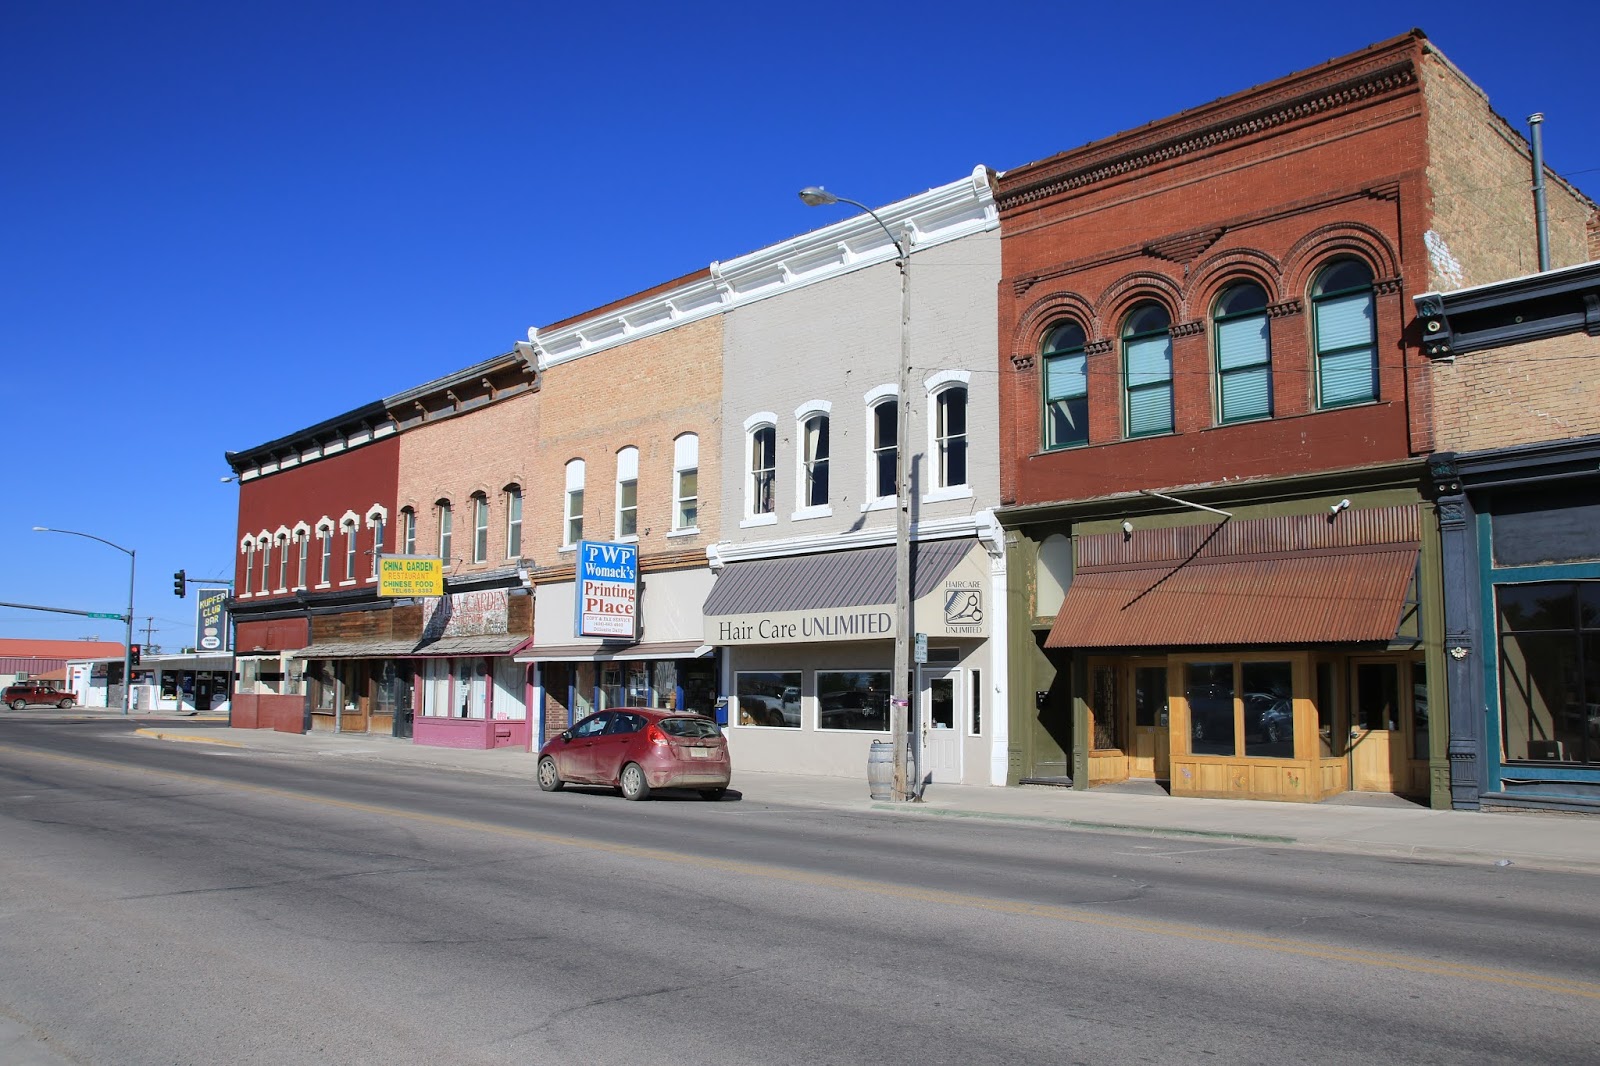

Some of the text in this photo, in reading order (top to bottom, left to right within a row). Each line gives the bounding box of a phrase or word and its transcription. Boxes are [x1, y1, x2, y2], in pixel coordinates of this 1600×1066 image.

[383, 561, 433, 571] CHINA GARDEN
[585, 562, 634, 580] Womack's
[388, 572, 430, 580] RESTAURANT
[383, 580, 412, 588] CHINESE
[945, 580, 982, 588] HAIRCARE
[584, 581, 635, 602] Printing
[202, 604, 222, 618] CLUB
[585, 598, 634, 614] Place
[204, 615, 219, 627] BAR
[719, 612, 892, 641] Hair Care UNLIMITED
[945, 626, 983, 634] UNLIMITED
